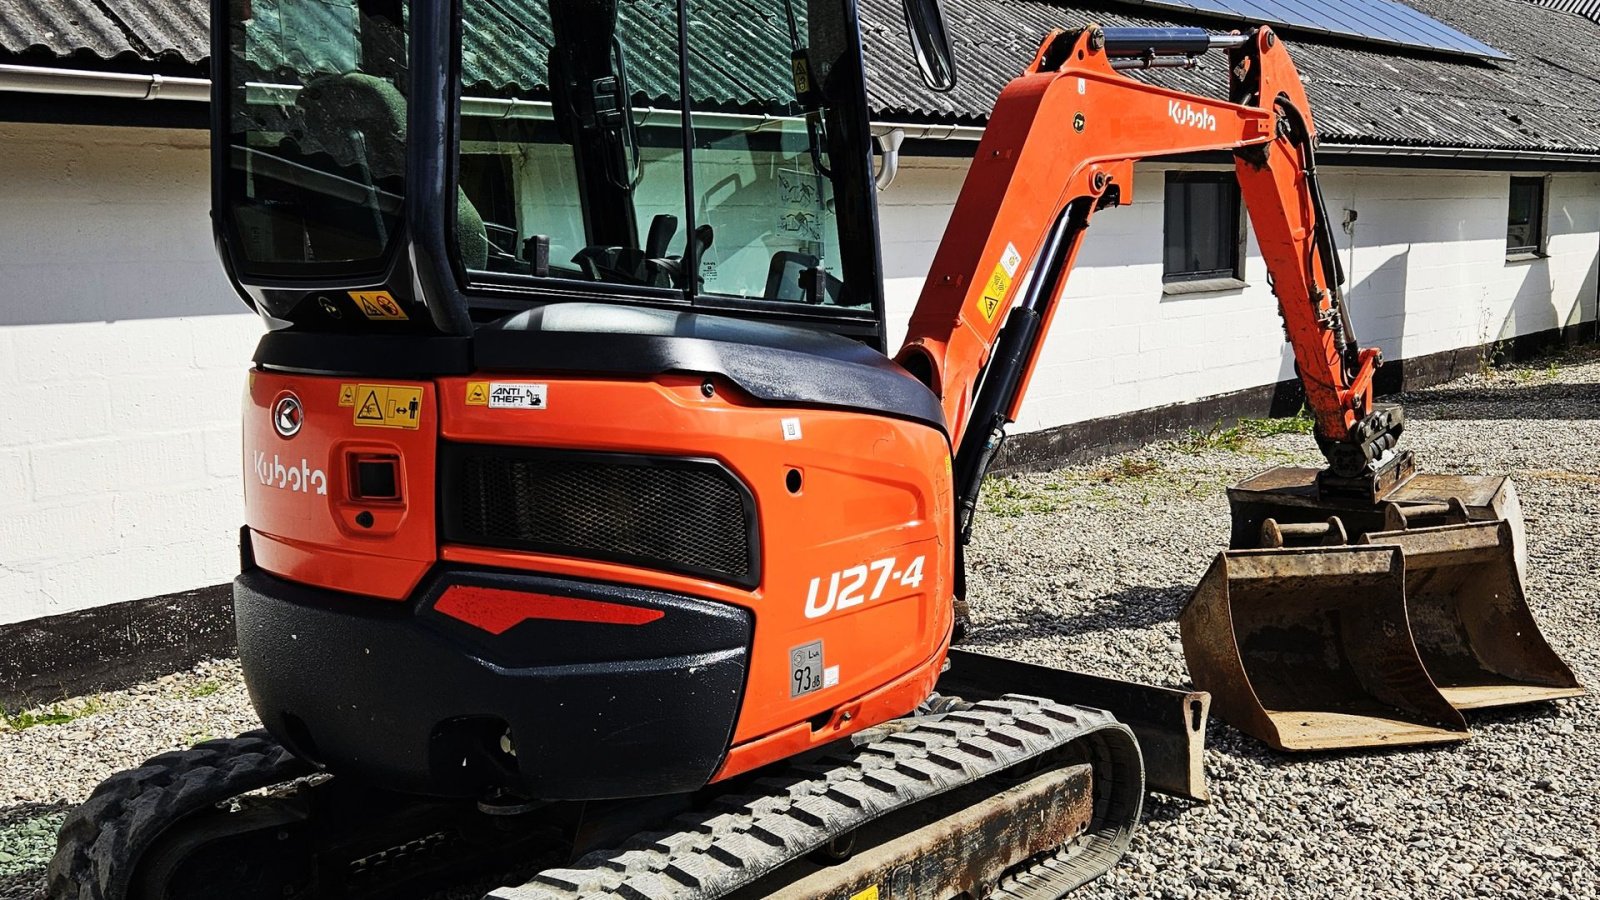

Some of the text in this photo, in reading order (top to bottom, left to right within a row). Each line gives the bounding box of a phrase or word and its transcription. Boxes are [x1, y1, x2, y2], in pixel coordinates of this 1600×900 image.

[1168, 99, 1216, 132] Kubota
[491, 395, 526, 404] THEFT
[492, 387, 521, 396] ANTI
[253, 450, 327, 496] Kubota
[804, 555, 926, 619] U27-4
[794, 666, 811, 694] 93
